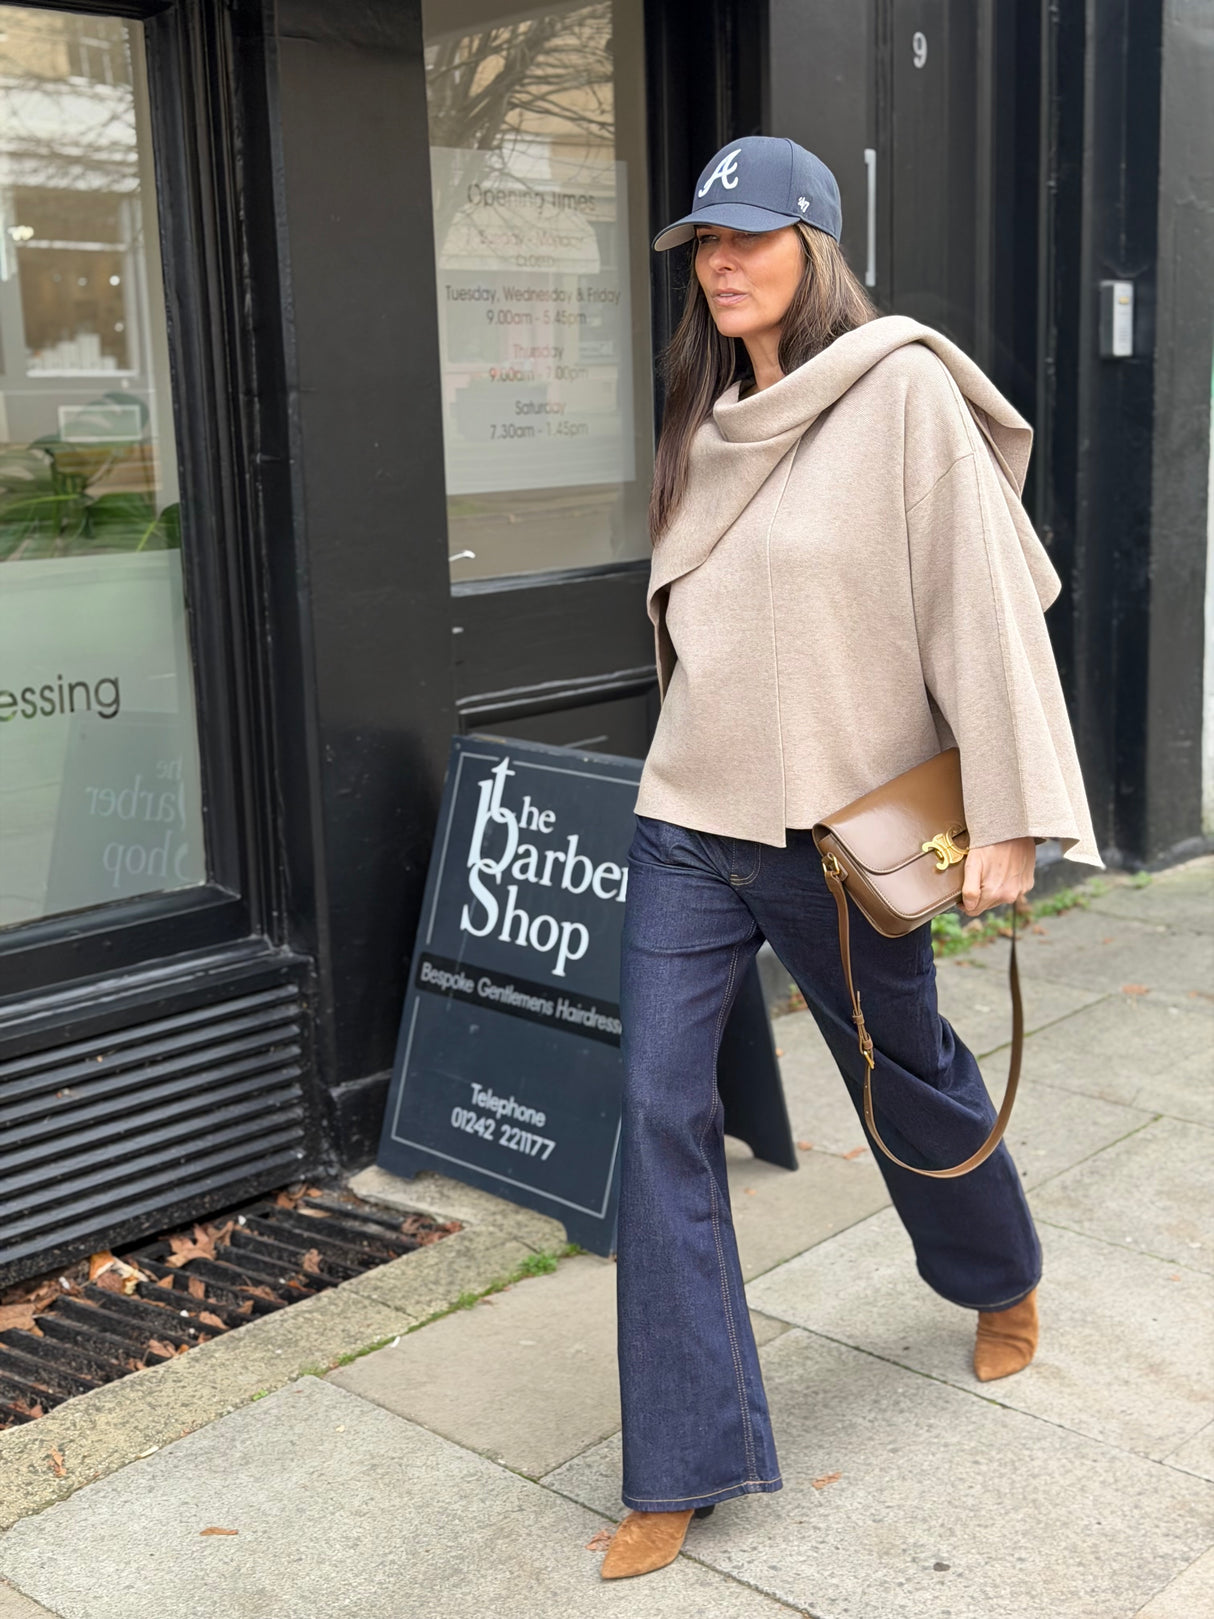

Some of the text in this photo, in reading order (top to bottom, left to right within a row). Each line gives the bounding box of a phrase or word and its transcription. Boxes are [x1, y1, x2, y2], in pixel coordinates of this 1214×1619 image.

[912, 31, 928, 69] 9
[698, 148, 742, 198] A
[467, 183, 545, 216] Opening
[503, 285, 573, 304] Wednesday
[576, 287, 584, 302] &
[587, 287, 621, 305] Friday
[486, 309, 533, 325] 9.00am
[512, 343, 565, 361] Thursday
[514, 400, 567, 416] Saturday
[489, 424, 535, 440] 7.30am
[545, 421, 589, 437] 1.45pm
[460, 864, 590, 977] Shop
[419, 961, 622, 1035] Bespoke Gentlemens Hairdress
[470, 1081, 547, 1128] Telephone
[450, 1106, 557, 1161] 01242 221177
